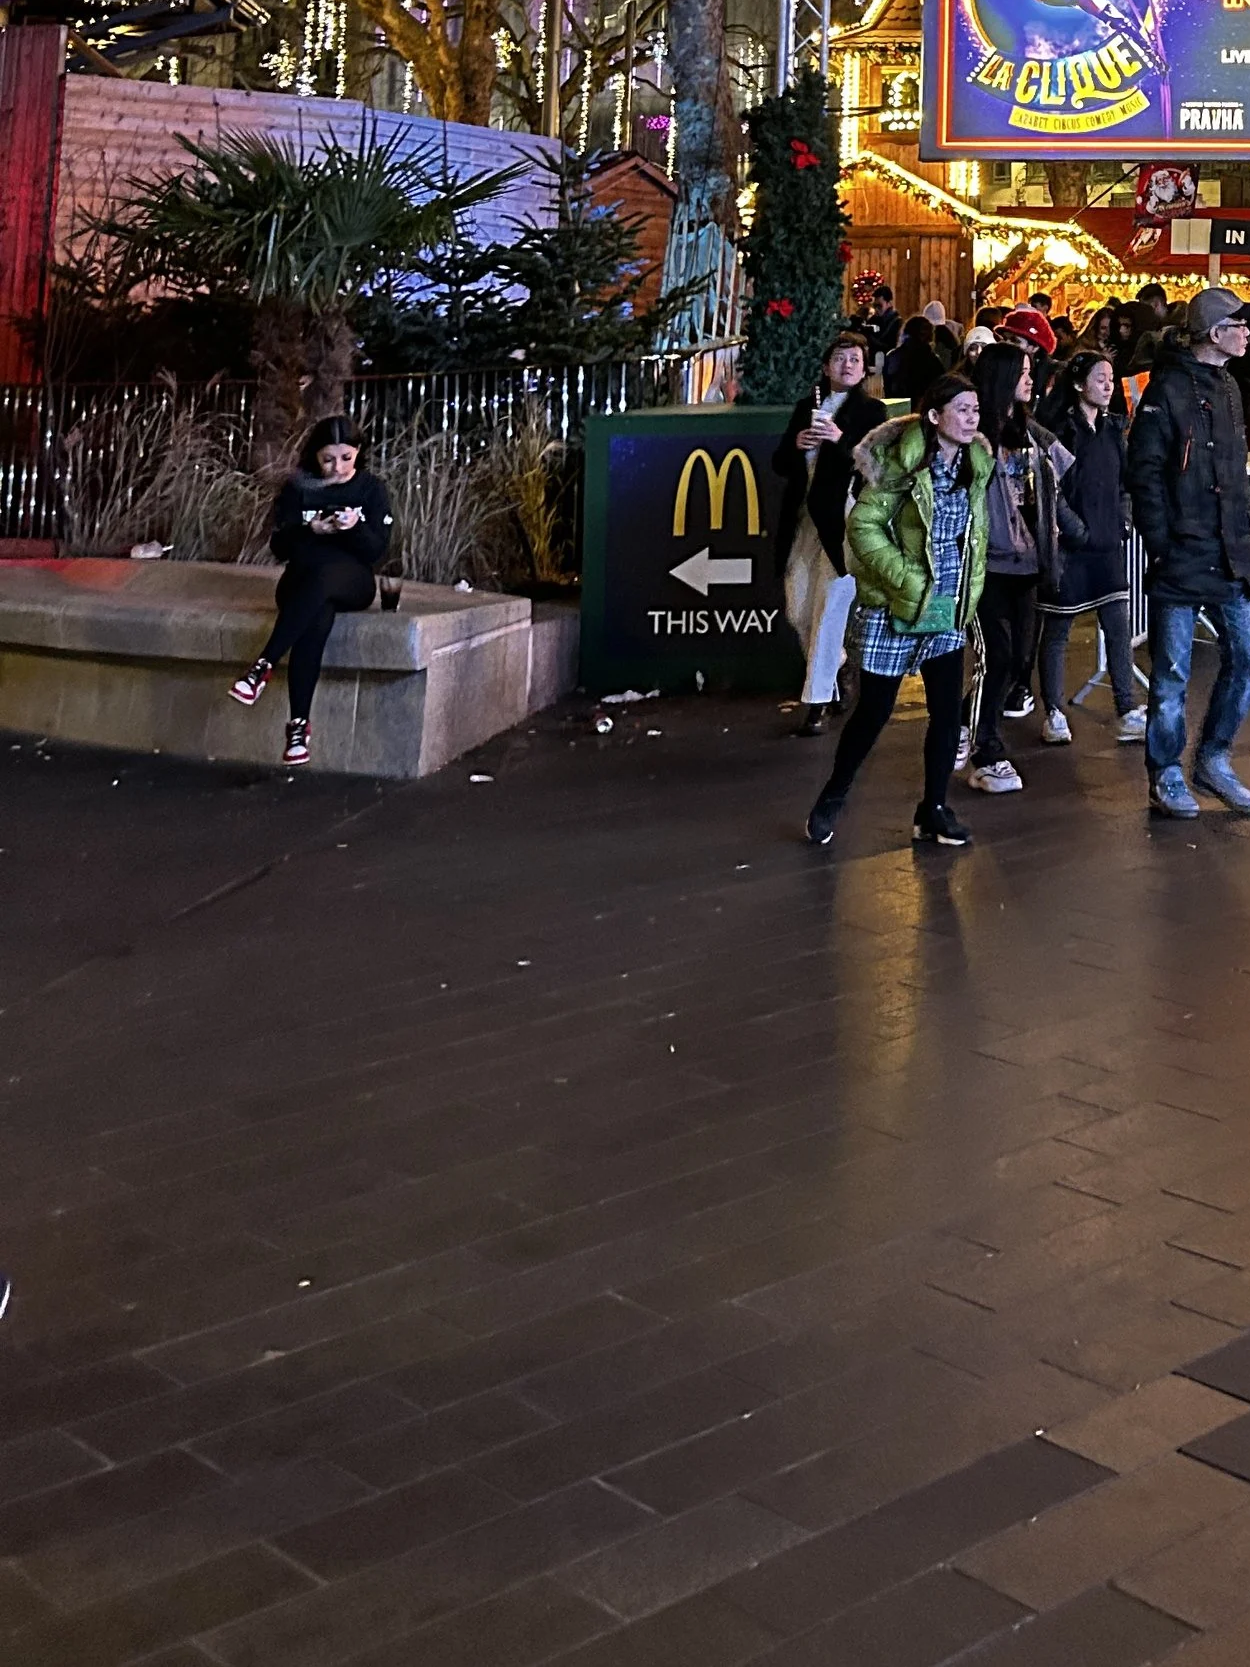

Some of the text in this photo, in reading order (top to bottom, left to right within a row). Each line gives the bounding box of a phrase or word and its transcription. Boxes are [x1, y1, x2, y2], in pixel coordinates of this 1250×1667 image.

[976, 33, 1143, 109] LA CLIQUE
[1180, 108, 1244, 131] PRAVHA
[1225, 229, 1245, 245] IN
[647, 609, 779, 634] THIS WAY
